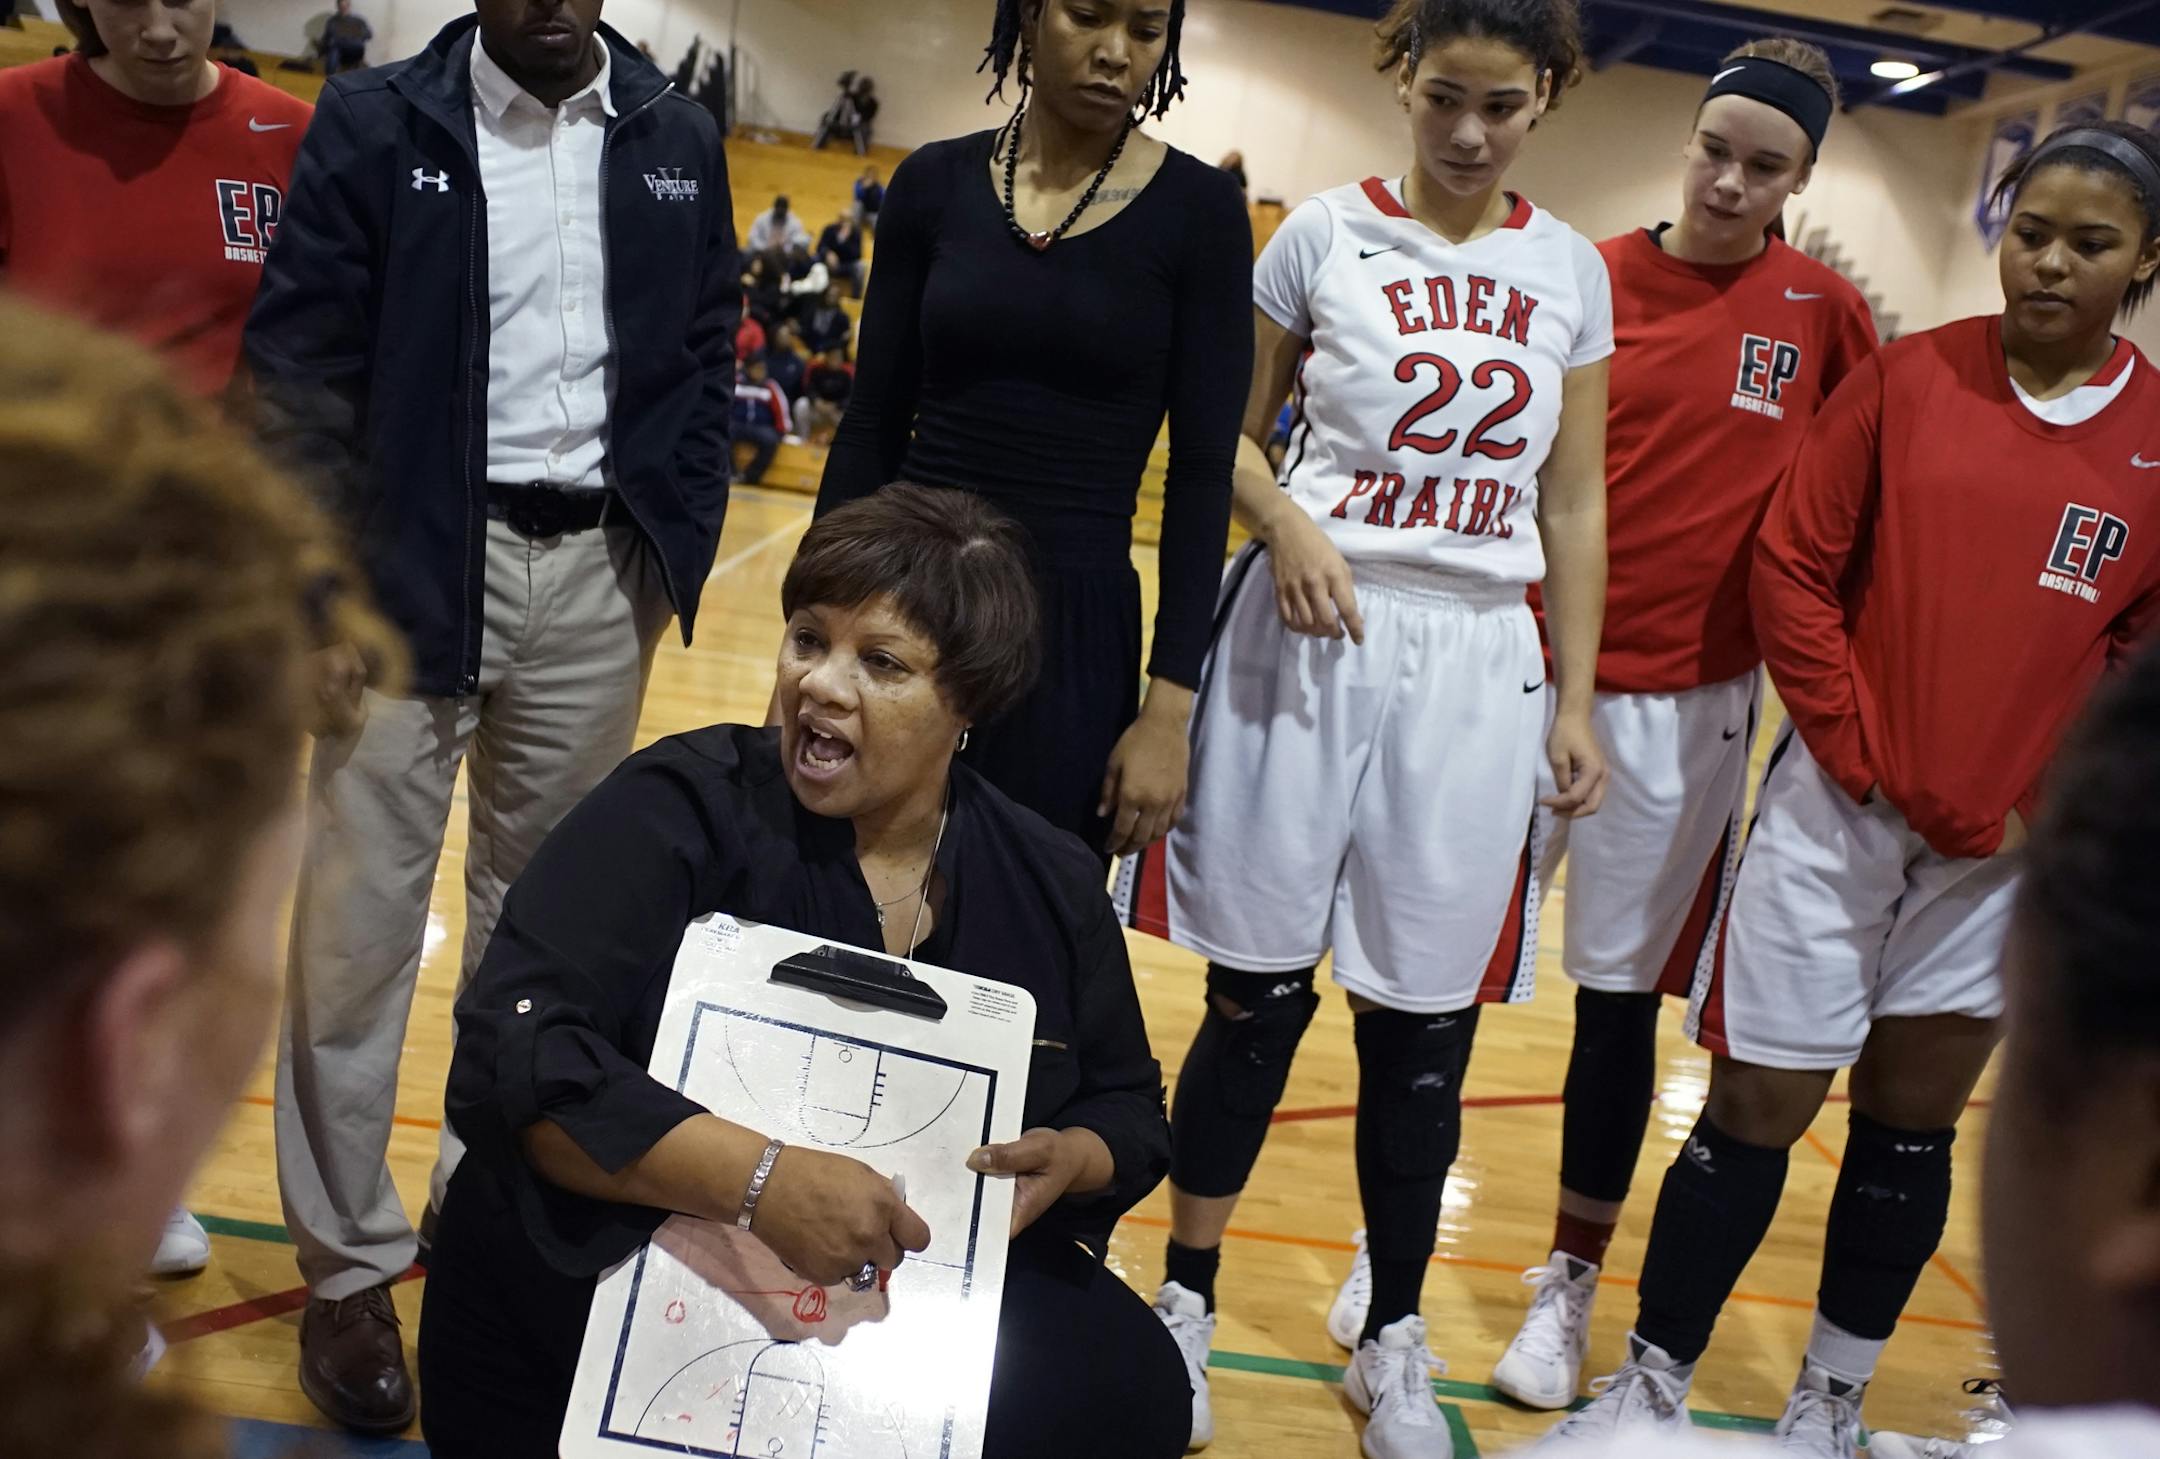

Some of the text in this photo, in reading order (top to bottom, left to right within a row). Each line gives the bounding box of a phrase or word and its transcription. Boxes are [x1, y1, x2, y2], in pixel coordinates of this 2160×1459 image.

[215, 178, 281, 249] EP
[224, 246, 267, 265] BASKET
[1381, 274, 1539, 346] EDEN
[1736, 332, 1801, 402] EP
[1388, 351, 1533, 460] 22
[2046, 502, 2130, 584] EP
